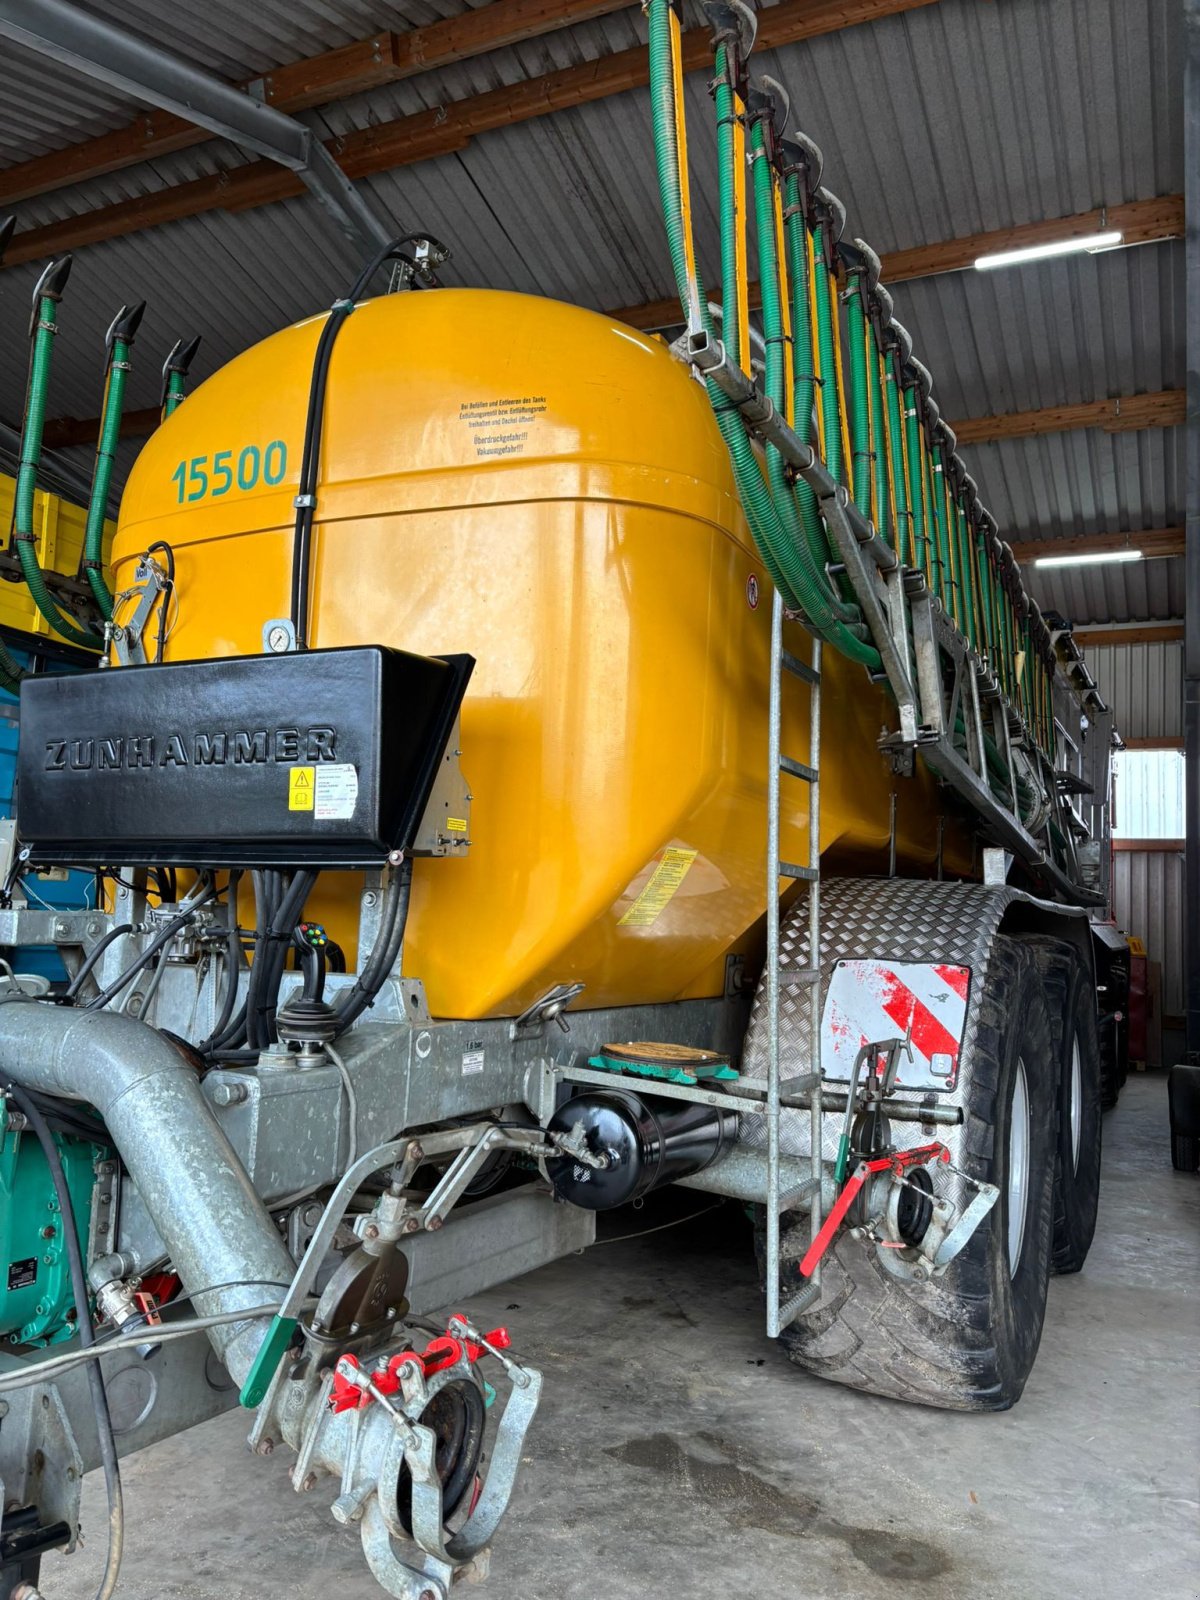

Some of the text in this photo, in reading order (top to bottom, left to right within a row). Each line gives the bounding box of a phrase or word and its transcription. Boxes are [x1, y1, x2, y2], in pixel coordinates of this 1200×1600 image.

[492, 418, 501, 426] und
[502, 416, 517, 424] Deckel
[171, 439, 287, 504] 15500
[136, 567, 147, 578] Voll
[44, 726, 337, 771] ZUNHAMMER
